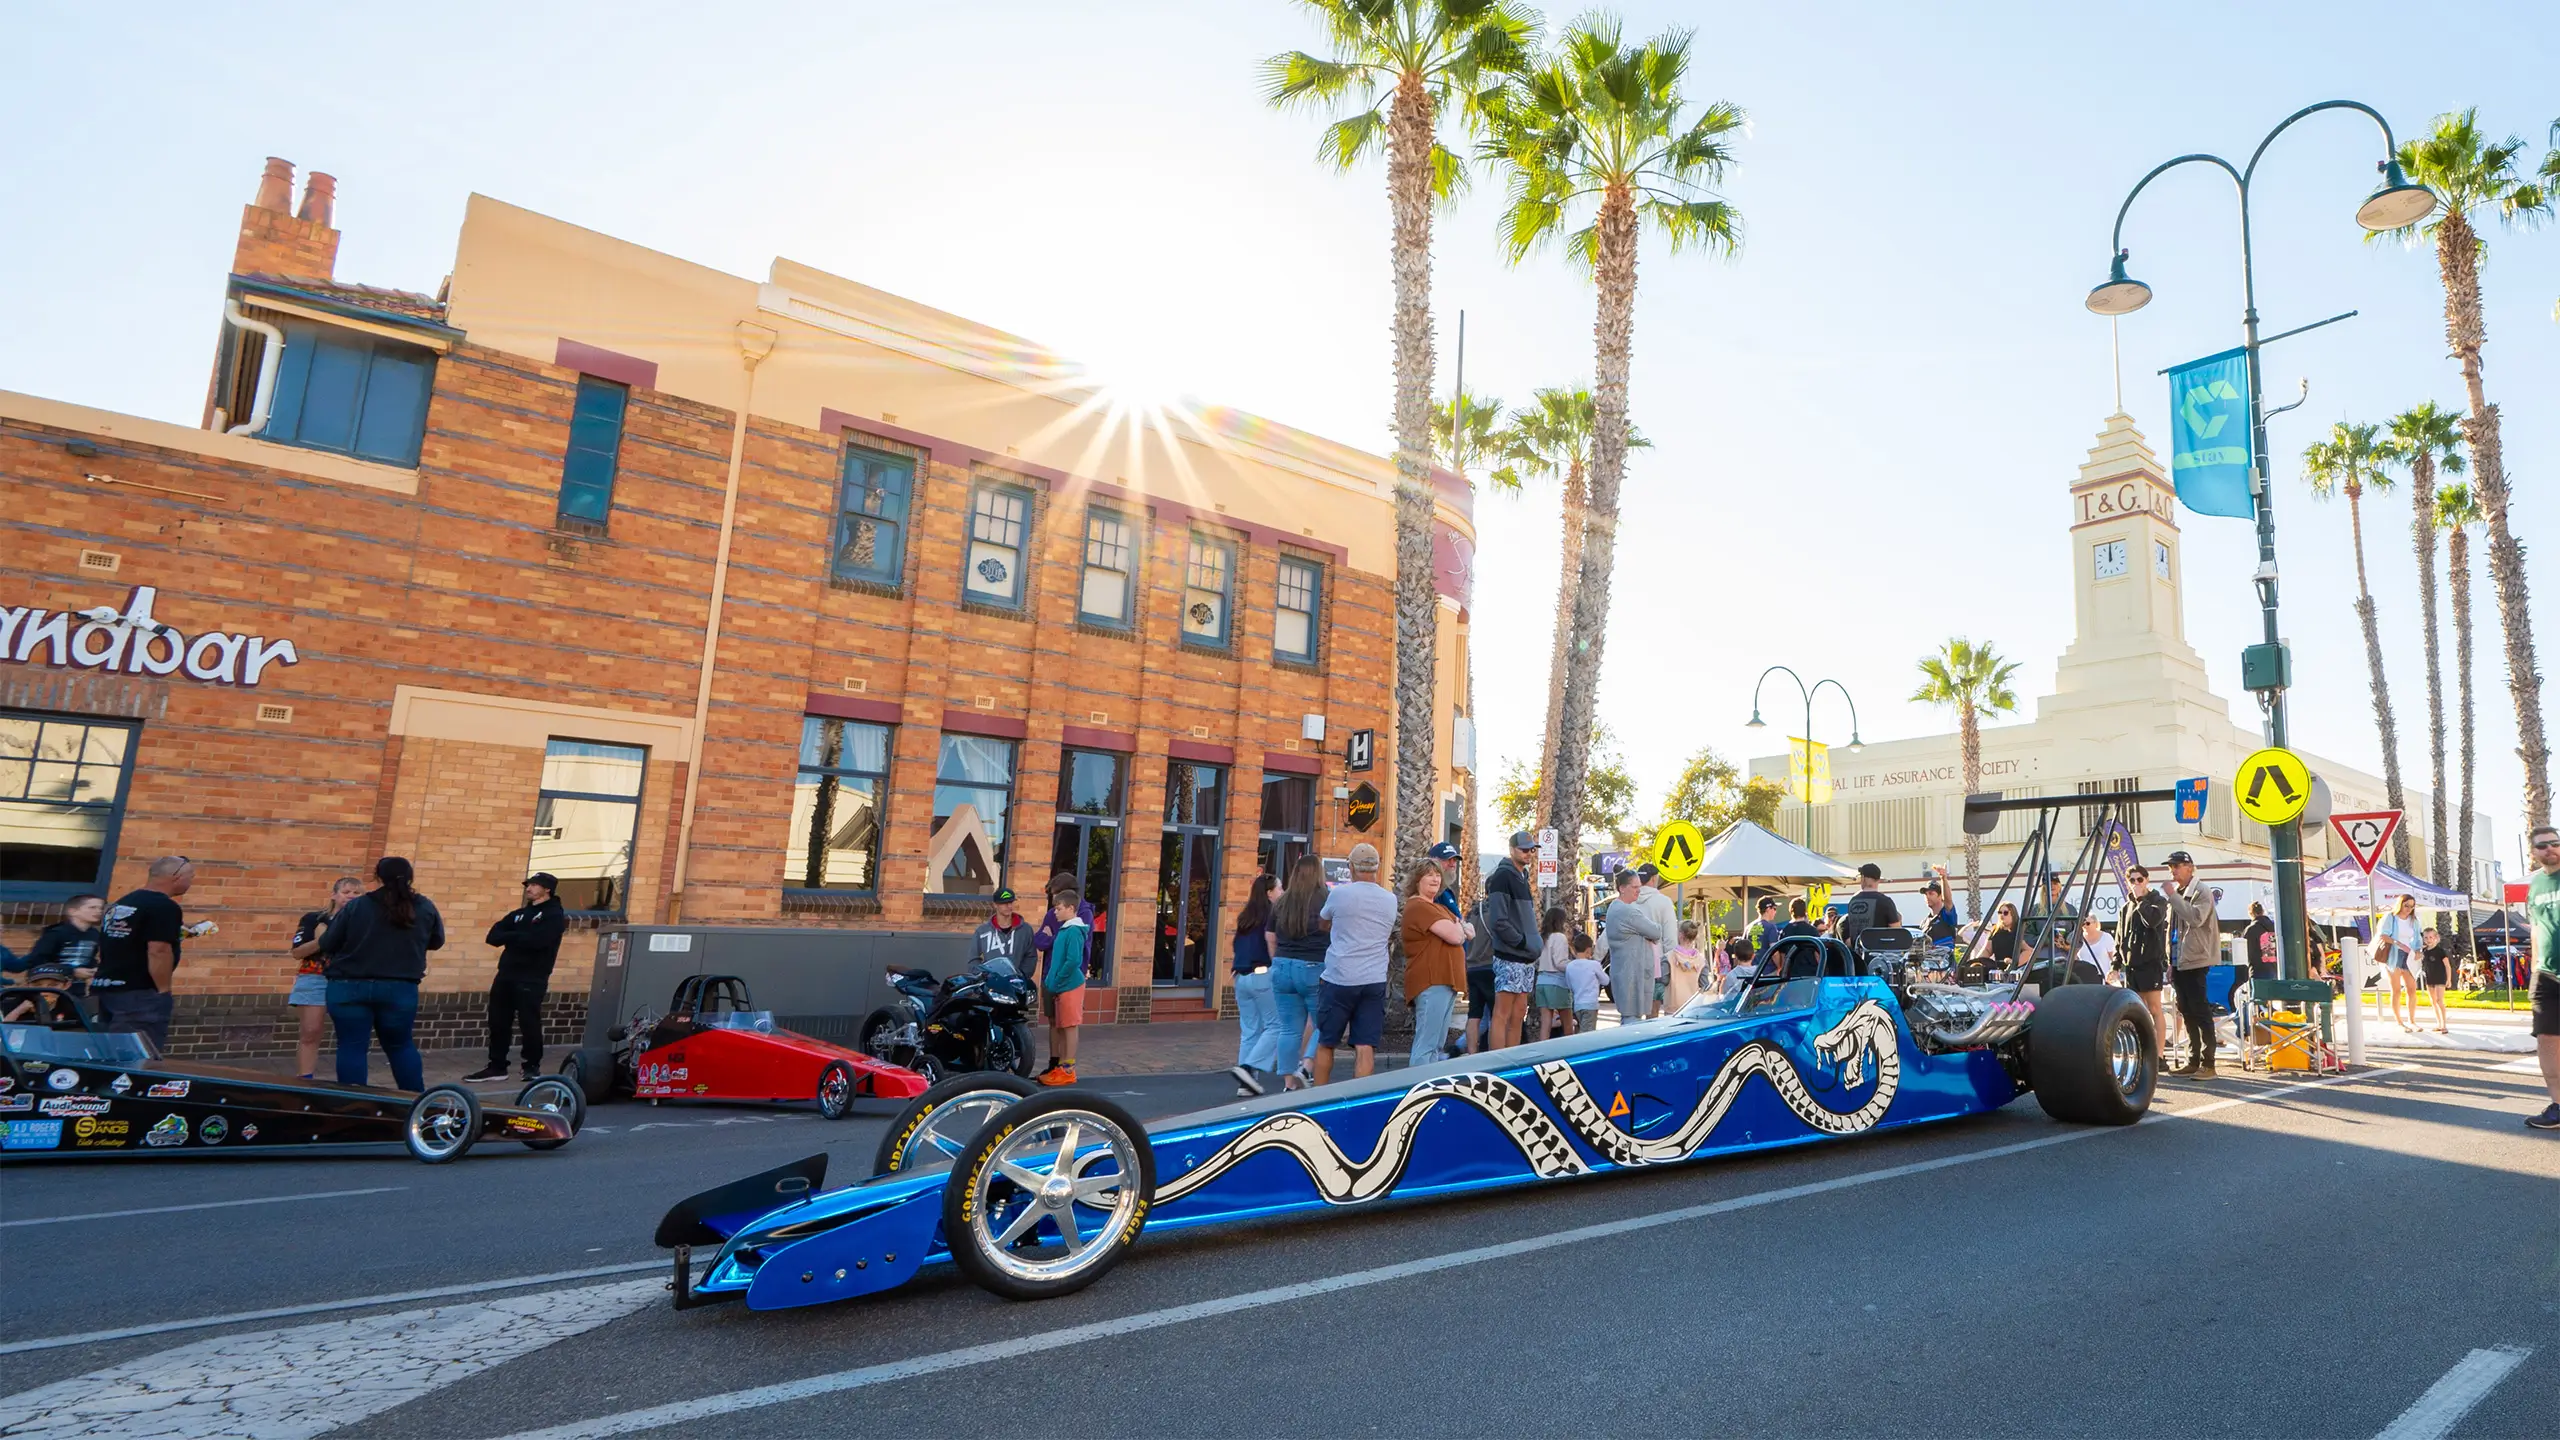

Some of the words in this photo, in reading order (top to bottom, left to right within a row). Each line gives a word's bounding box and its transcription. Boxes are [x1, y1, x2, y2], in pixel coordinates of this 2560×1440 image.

[2193, 451, 2227, 464] stay
[2098, 493, 2116, 513] &
[1353, 733, 1369, 760] H
[1853, 774, 1876, 788] LIFE
[1881, 766, 1955, 786] ASSURANCE
[1542, 860, 1555, 868] TAXI
[980, 930, 1016, 955] 741
[43, 1100, 109, 1111] Audisound
[962, 1123, 1013, 1222] GOODYEAR
[1121, 1198, 1149, 1246] EAGLE
